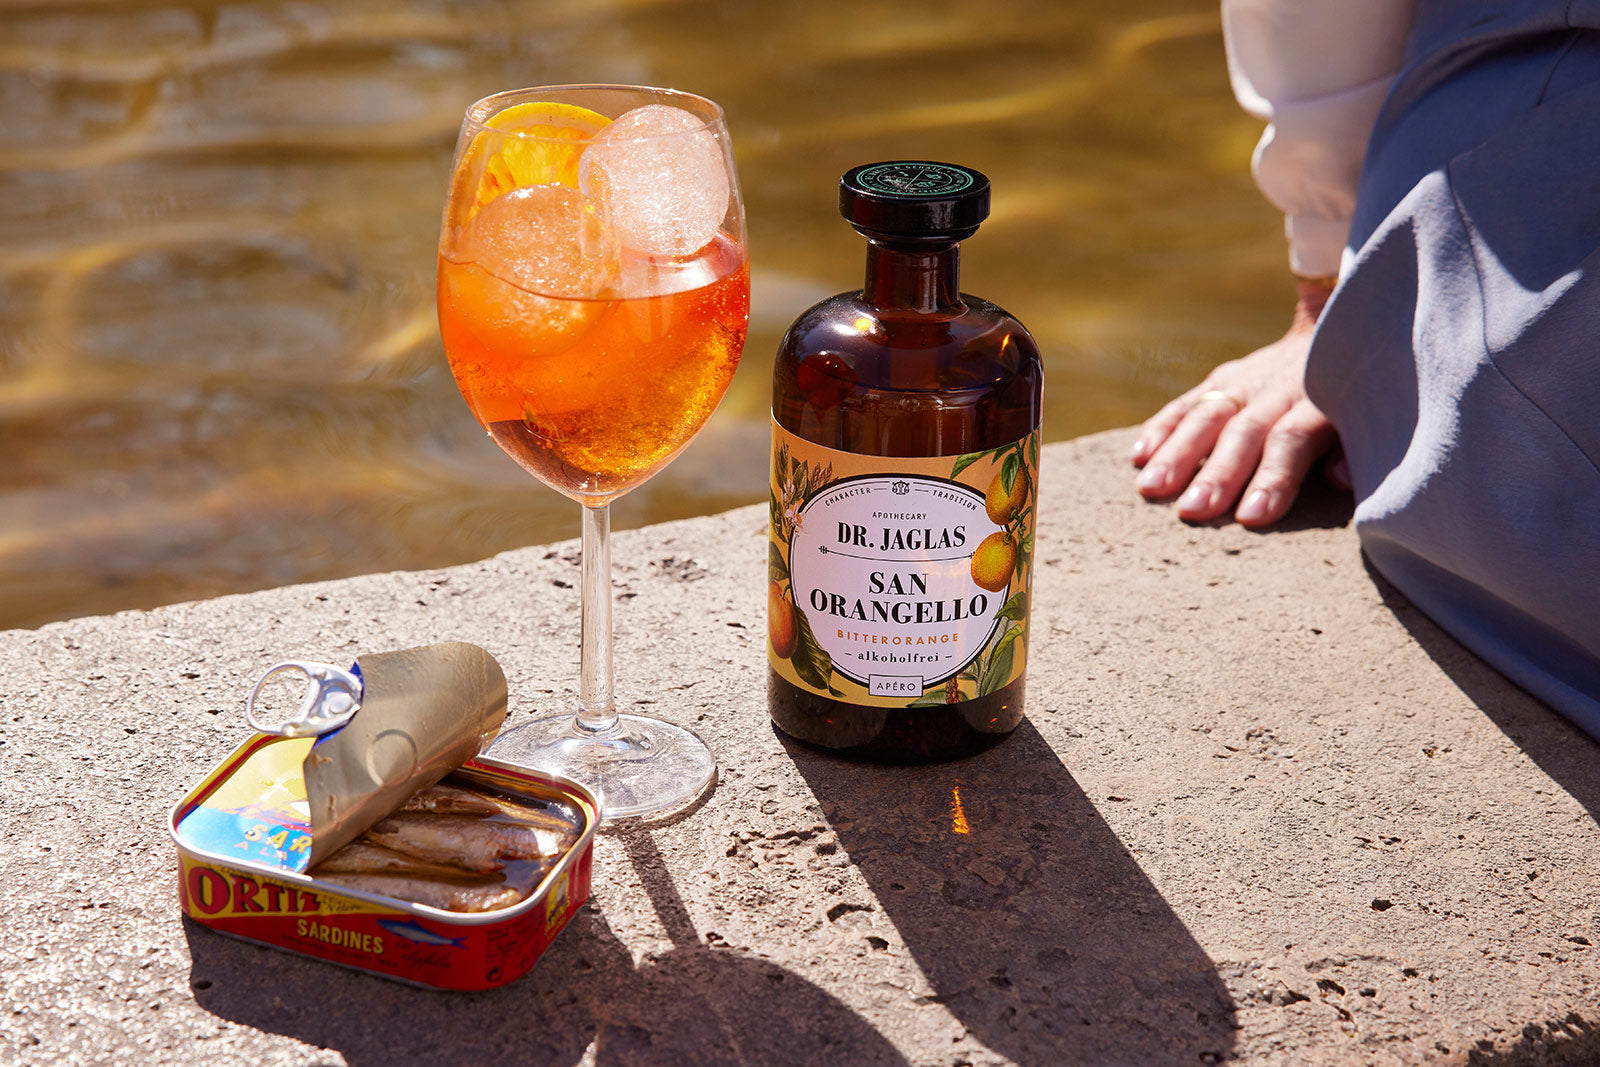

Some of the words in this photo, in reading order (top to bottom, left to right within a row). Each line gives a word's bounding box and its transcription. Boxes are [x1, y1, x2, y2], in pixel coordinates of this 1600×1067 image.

[824, 487, 871, 507] CHARACTER
[932, 489, 978, 511] TRADITION
[872, 511, 927, 520] APOTHECARY
[837, 521, 874, 548] DR.
[880, 525, 966, 551] JAGLAS
[868, 571, 928, 595] SAN
[810, 588, 988, 624] ORANGELLO
[837, 629, 959, 645] BITTERORANGE
[857, 651, 940, 663] alkoholfrei
[876, 680, 916, 692] APÉRO
[187, 865, 321, 915] ORTIZ
[297, 918, 384, 955] SARDINES
